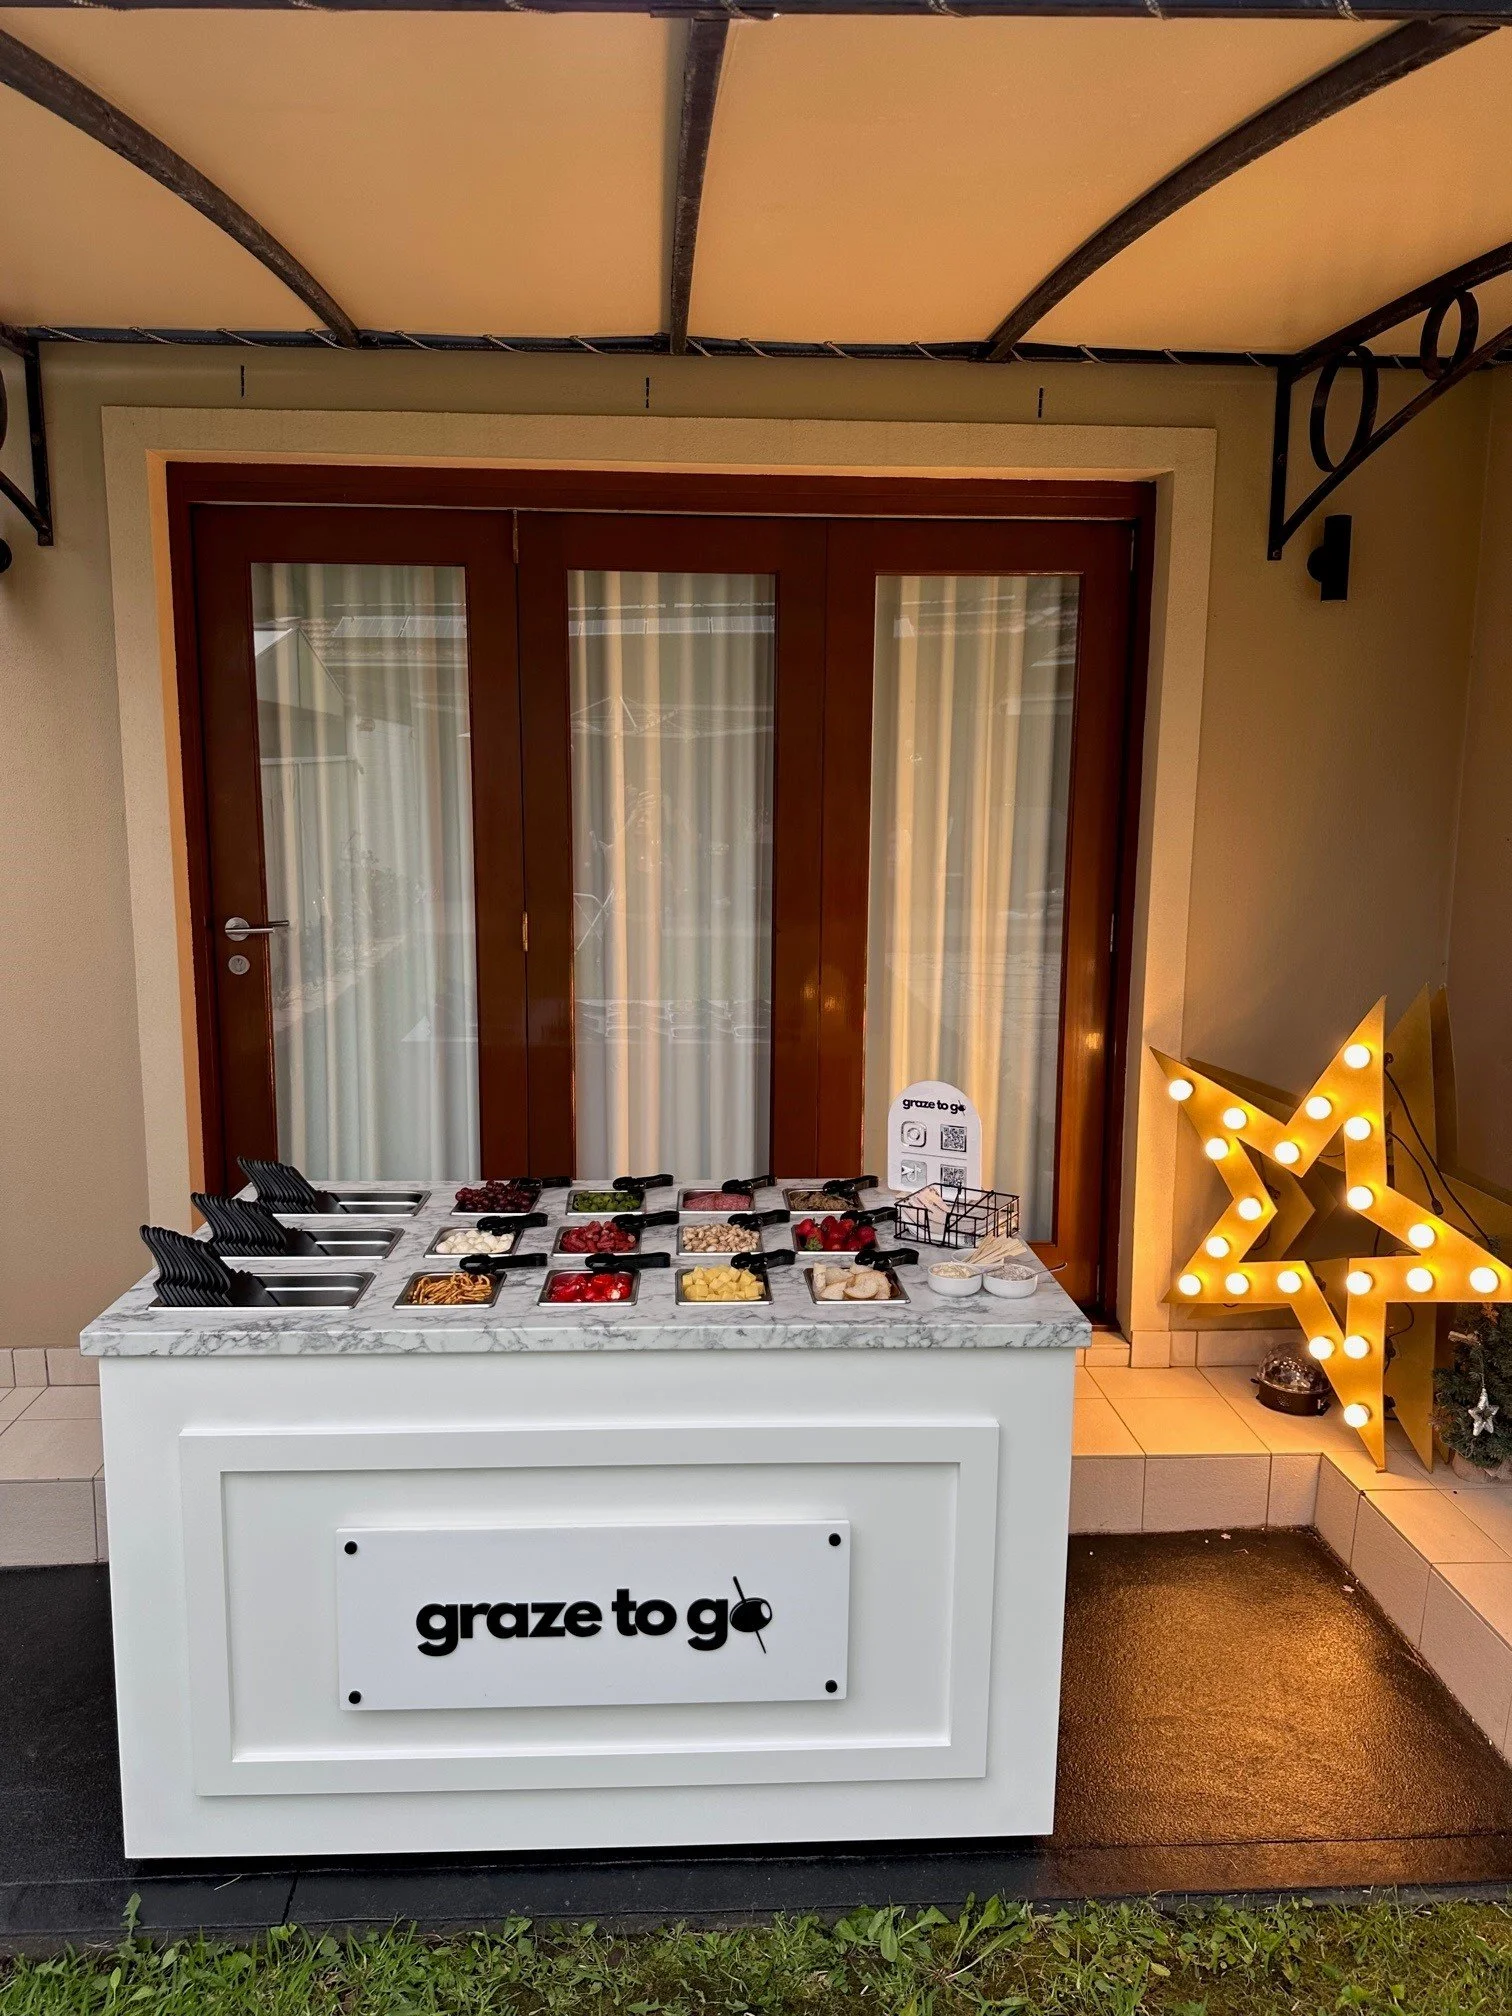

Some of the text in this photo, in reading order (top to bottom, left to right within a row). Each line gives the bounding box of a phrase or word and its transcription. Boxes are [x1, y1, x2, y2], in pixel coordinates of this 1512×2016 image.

[902, 1099, 966, 1115] graze to go
[416, 1582, 773, 1657] graze to go
